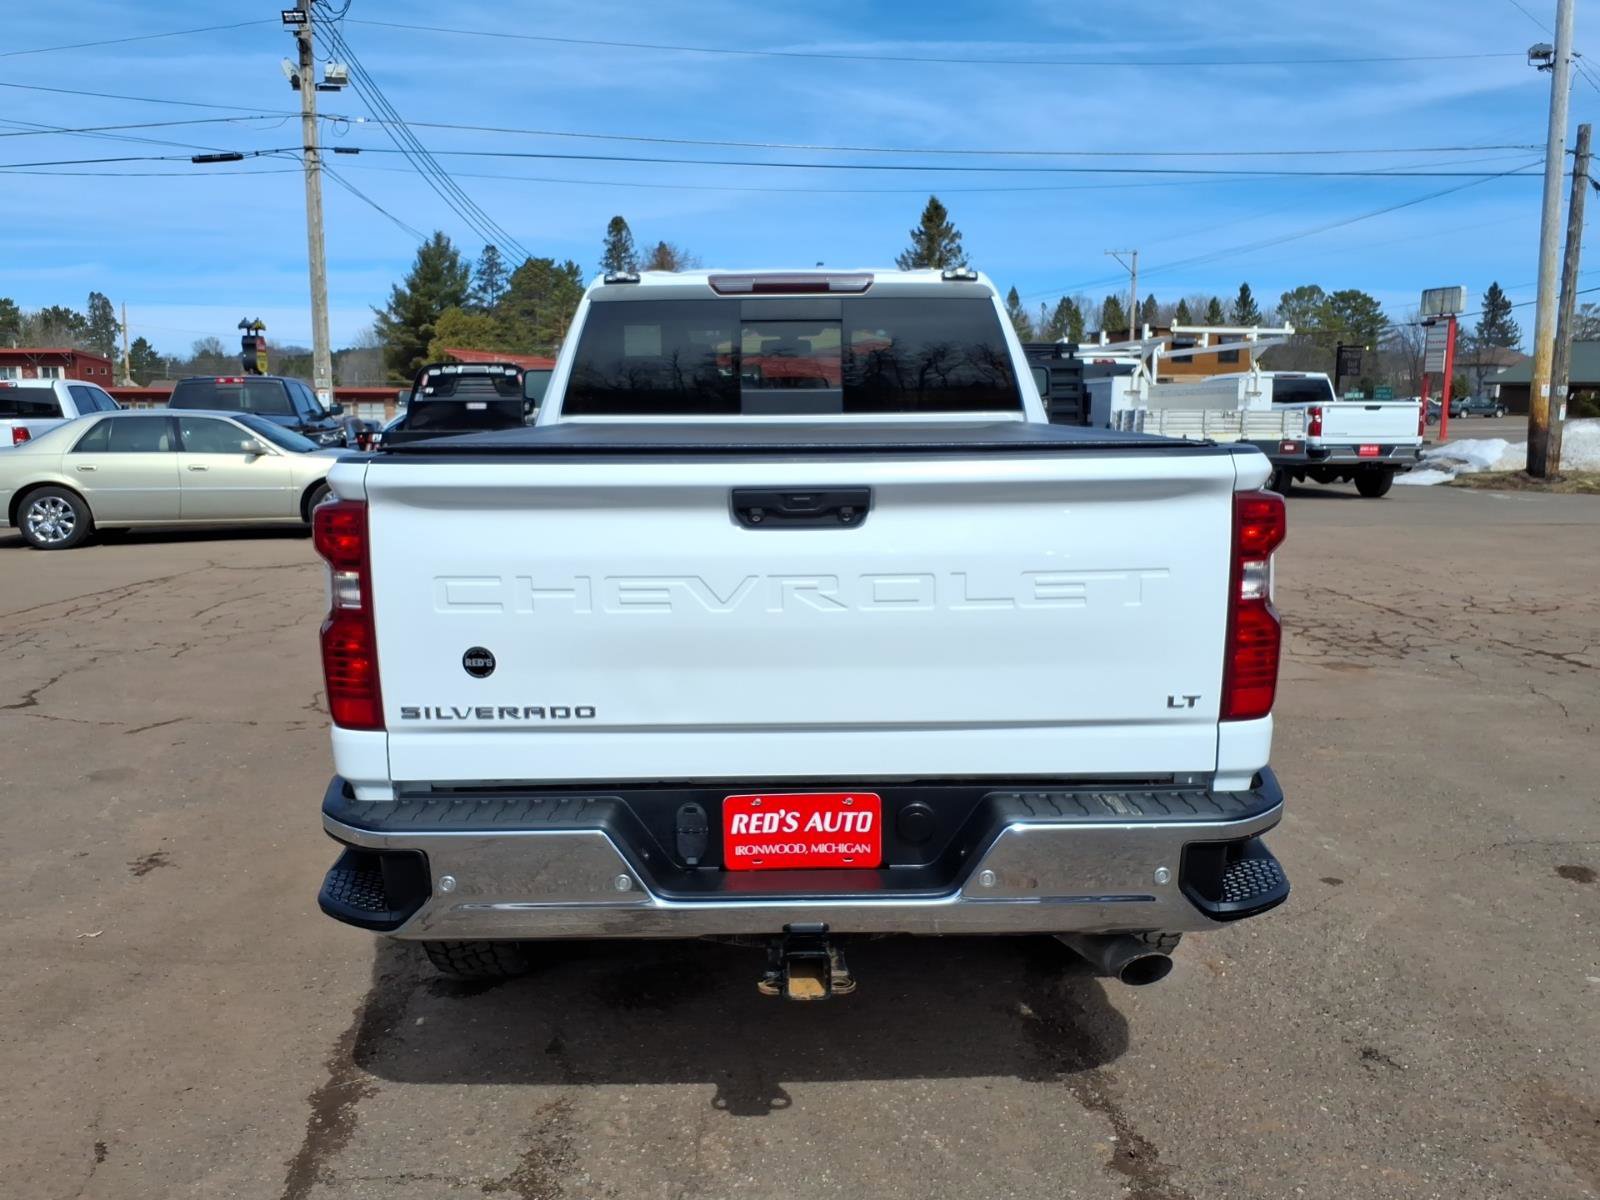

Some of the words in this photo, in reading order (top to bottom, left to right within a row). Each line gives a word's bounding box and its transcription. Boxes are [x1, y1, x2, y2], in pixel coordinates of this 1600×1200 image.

[433, 568, 1170, 615] CHEVROLET
[1167, 695, 1201, 708] LT
[400, 706, 596, 720] SILVERADO
[731, 809, 800, 834] RED'S
[804, 811, 873, 832] AUTO
[735, 843, 809, 856] IRONWOOD,
[811, 842, 871, 854] MICHIGAN
